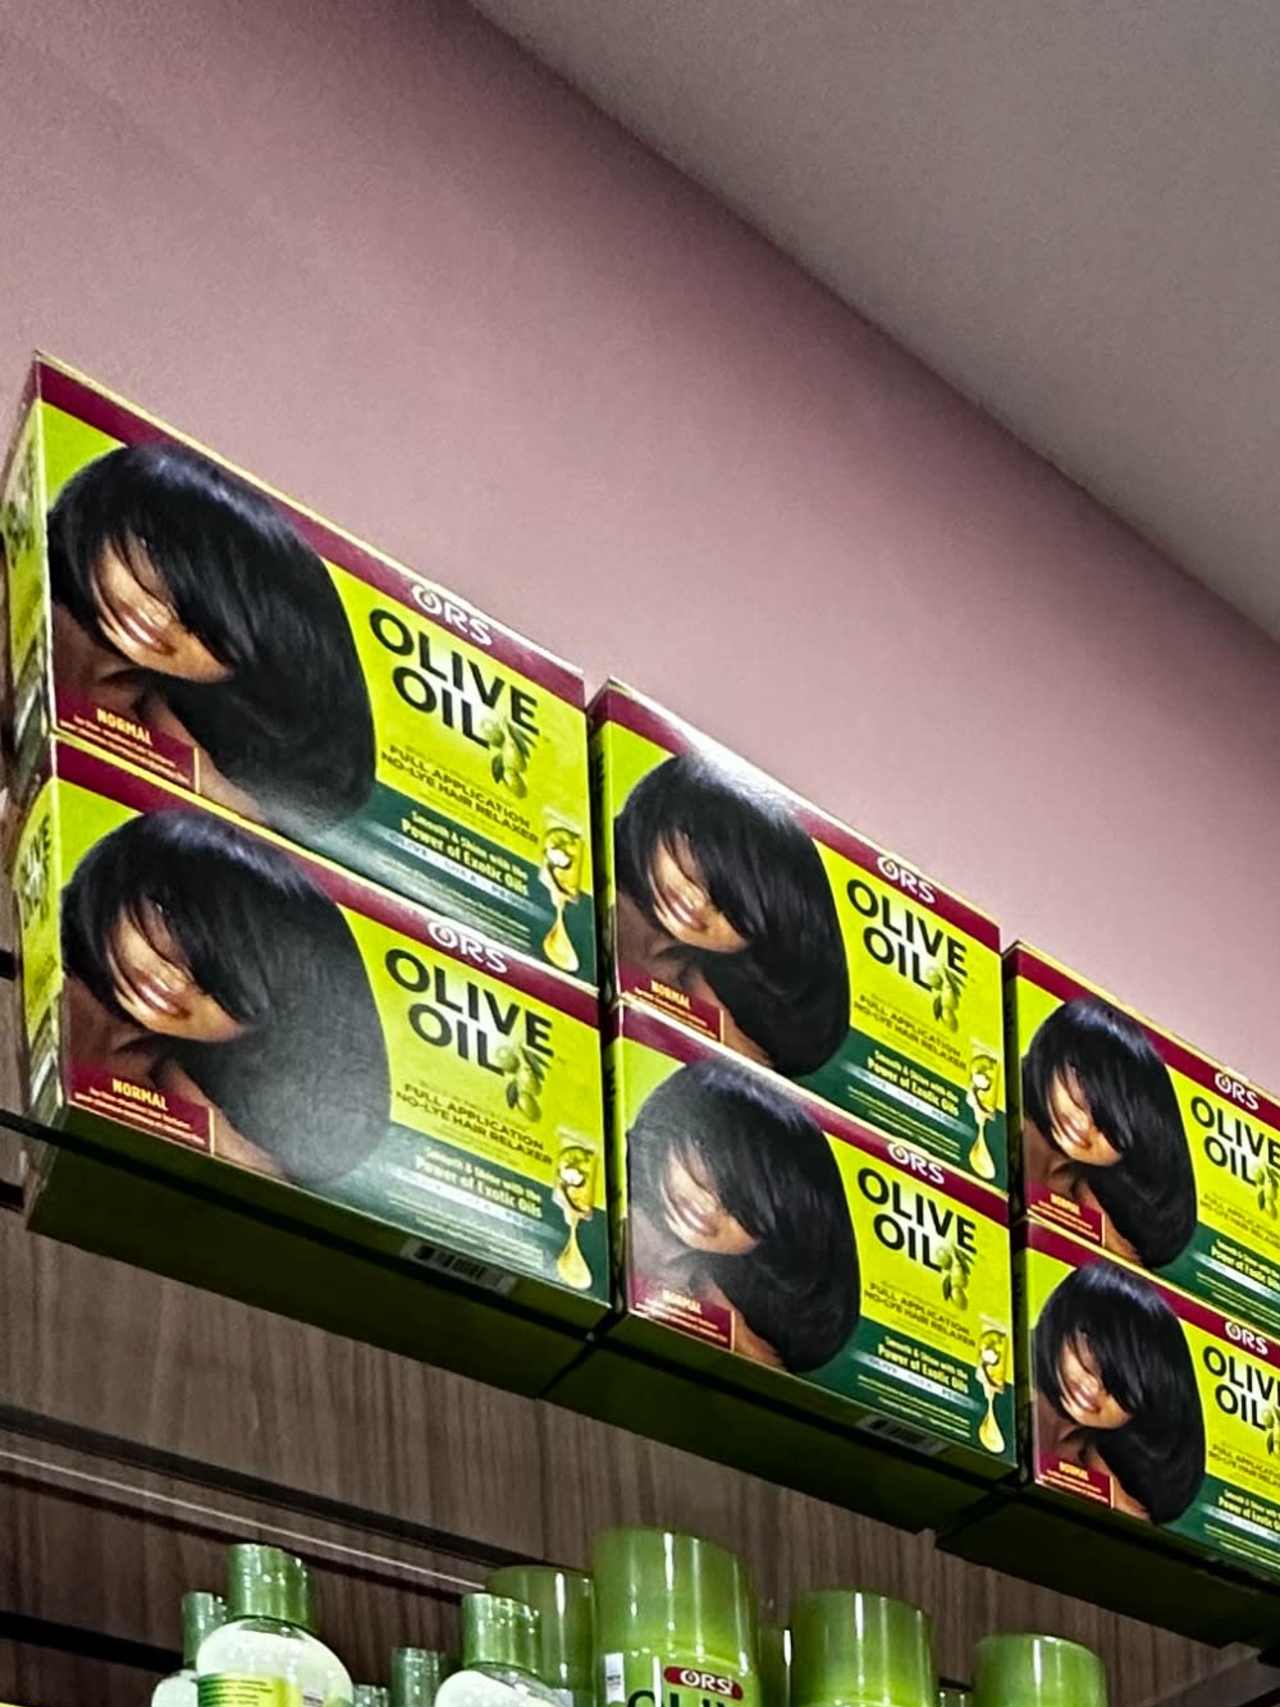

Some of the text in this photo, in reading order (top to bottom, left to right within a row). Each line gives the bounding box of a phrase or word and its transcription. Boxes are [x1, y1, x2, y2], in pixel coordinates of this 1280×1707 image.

[411, 584, 493, 647] ORS
[369, 608, 539, 736] OLIVE
[392, 666, 490, 749] OIL
[389, 743, 531, 829] FULL APPLICATION
[438, 780, 473, 808] HAIR
[474, 798, 539, 846] RELAXER
[876, 854, 937, 904] ORS
[428, 920, 508, 974] ORS
[846, 878, 968, 978] OLIVE
[863, 927, 933, 993] OIL
[385, 949, 554, 1057] OLIVE
[408, 1003, 505, 1077] OIL
[404, 1083, 544, 1151] FULL APPLICATION
[452, 1115, 488, 1138] HAIR
[490, 1130, 553, 1166] RELAXER
[886, 1140, 946, 1184] ORS
[1204, 1138, 1258, 1189] OIL
[857, 1167, 977, 1254] OLIVE
[873, 1213, 942, 1274] OIL
[1214, 1384, 1268, 1431] OIL
[679, 1668, 734, 1697] ORS
